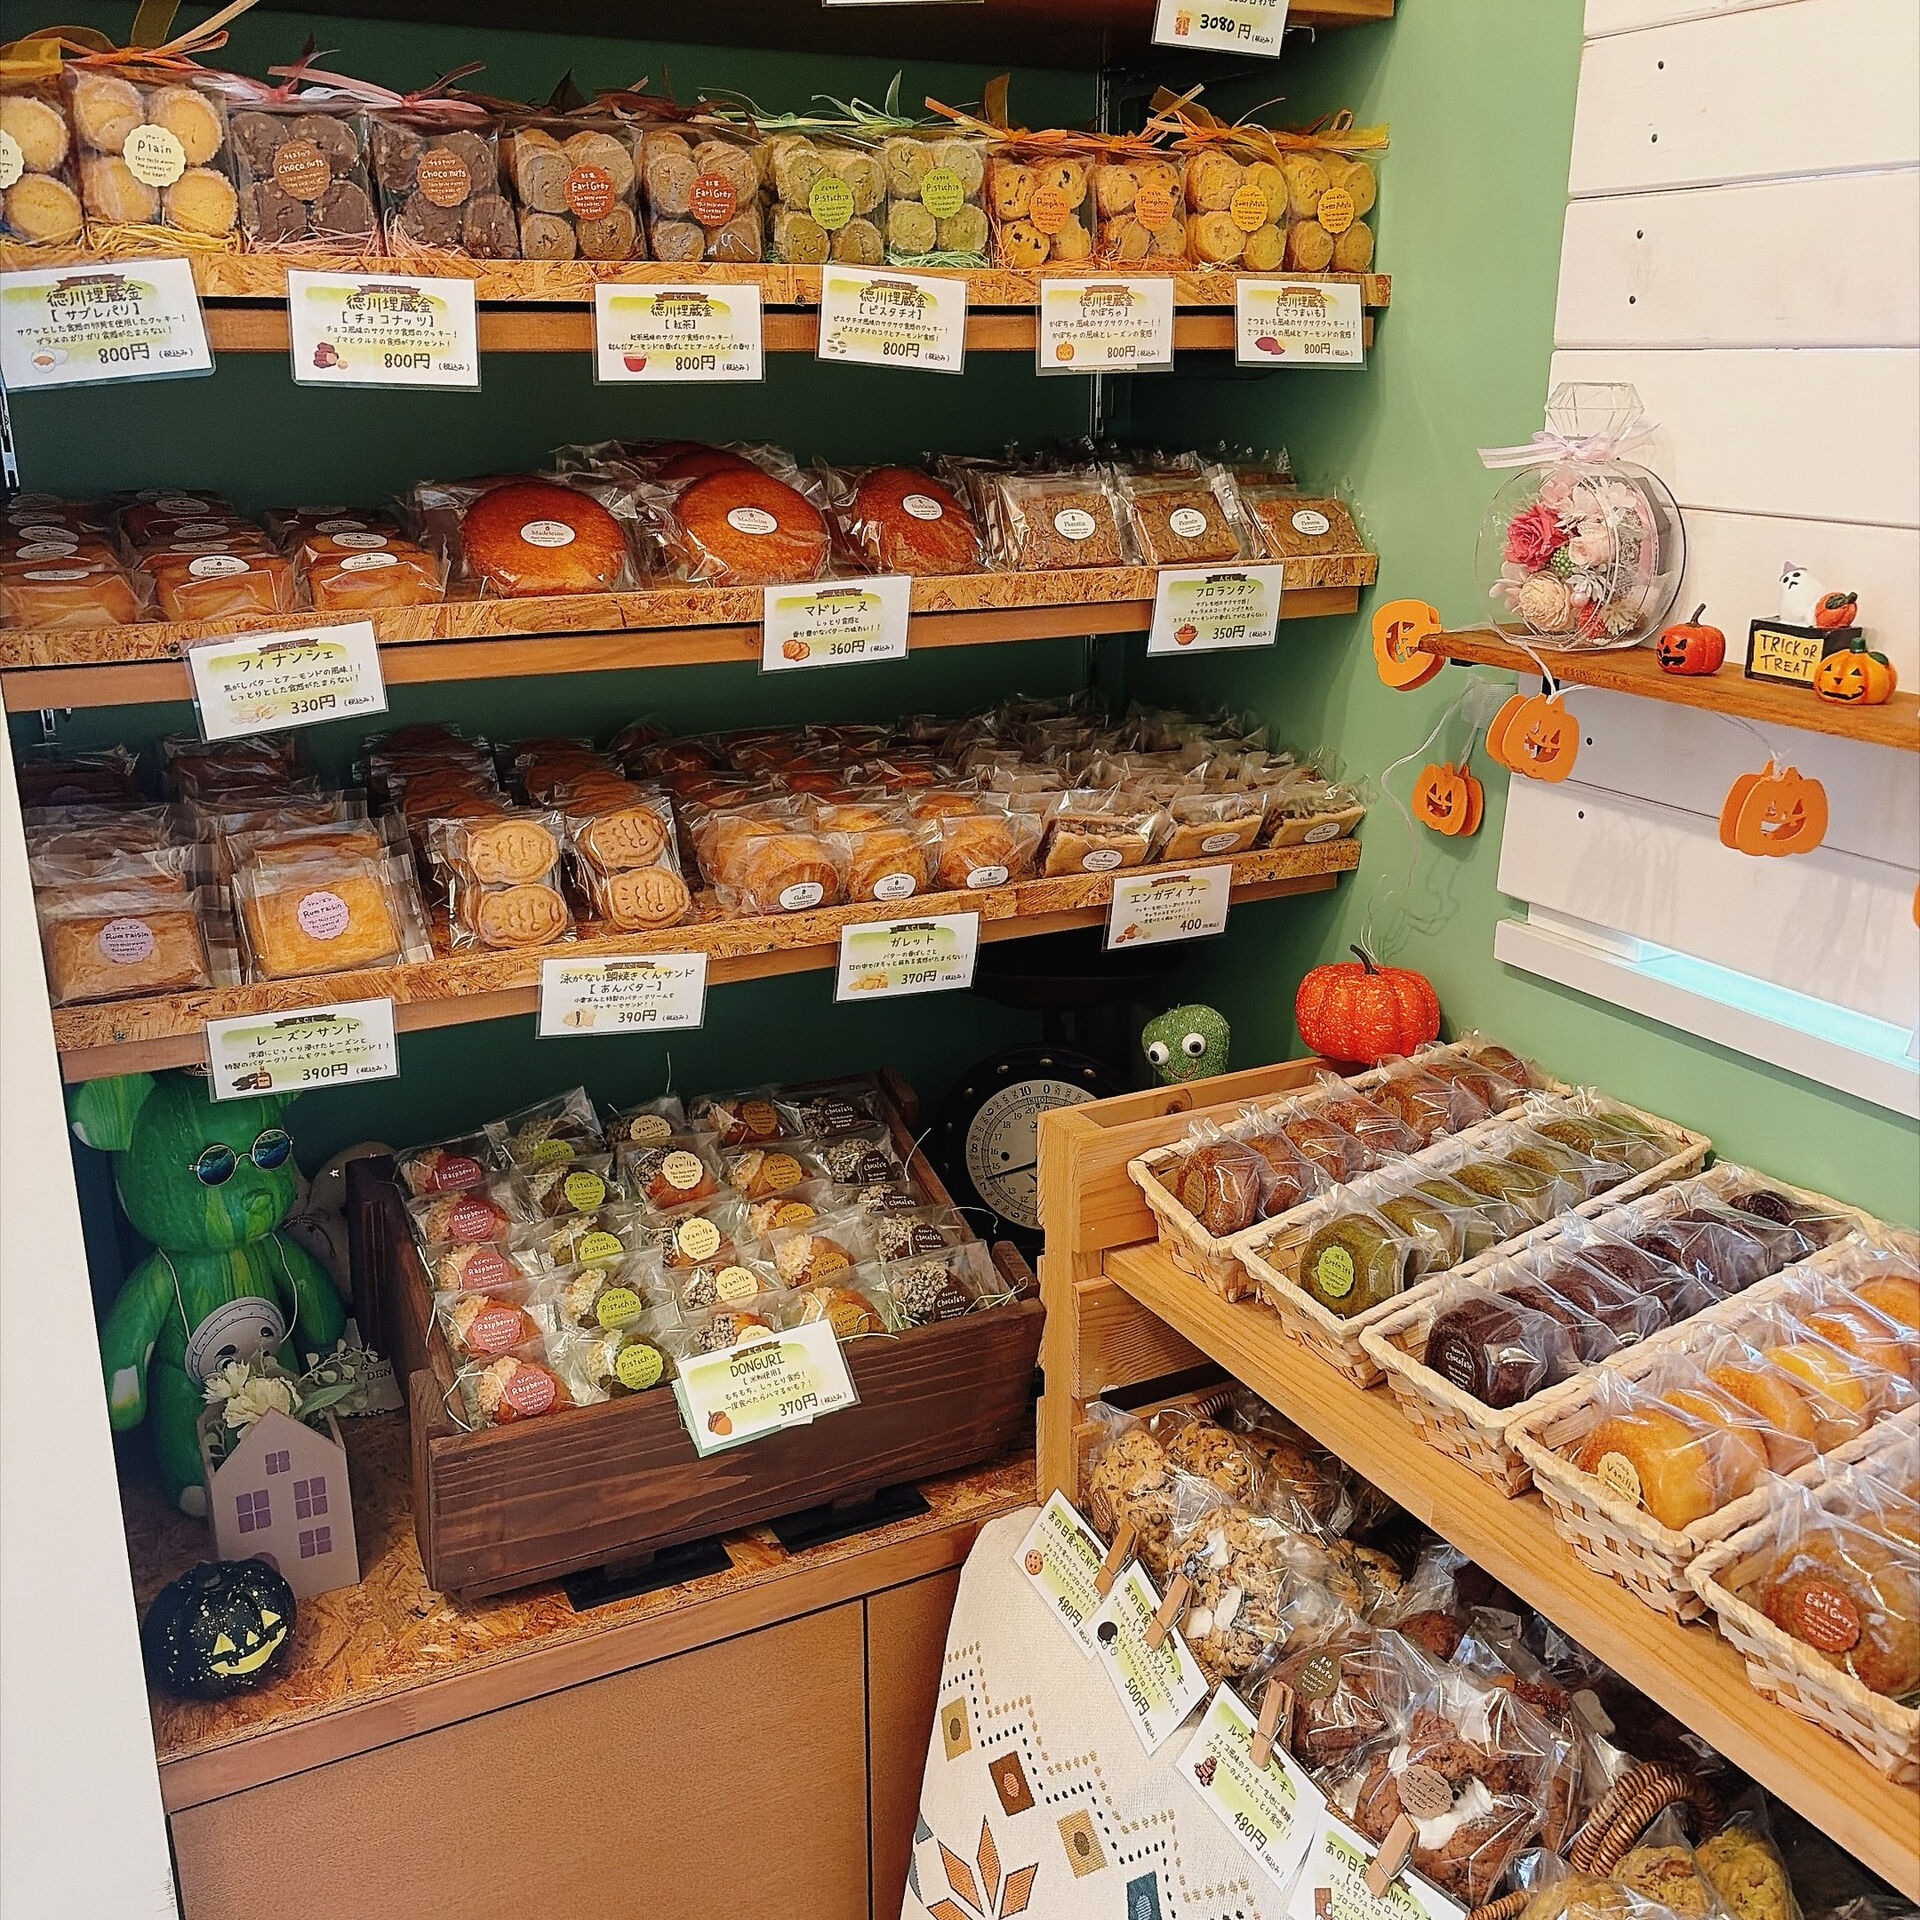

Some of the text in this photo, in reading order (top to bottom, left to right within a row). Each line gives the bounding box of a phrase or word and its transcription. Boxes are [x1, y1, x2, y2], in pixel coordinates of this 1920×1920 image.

[137, 139, 172, 154] Plain
[572, 182, 609, 191] Earl Grey
[695, 189, 732, 199] Earl Grey
[47, 283, 143, 307] 徳川埋蔵金
[859, 287, 928, 309] 徳川埋蔵金
[1079, 294, 1135, 307] 徳川埋蔵金
[1277, 295, 1328, 308] 徳川埋蔵金
[346, 294, 435, 313] 徳川埋蔵金
[651, 303, 714, 317] 徳川埋蔵金
[98, 342, 150, 363] 800円
[883, 341, 920, 358] 800円
[1107, 345, 1136, 358] 800円
[1304, 342, 1331, 355] 800円
[384, 352, 431, 369] 800円
[675, 355, 716, 371] 800円
[1196, 585, 1256, 598] フロランタン
[805, 601, 868, 616] マドレーヌ
[1212, 625, 1245, 640] 350円
[830, 639, 865, 655] 360円
[1760, 634, 1802, 656] TRICK
[237, 649, 334, 672] フィナンシェ
[1760, 654, 1812, 677] TREAT
[291, 694, 336, 714] 330円
[1130, 885, 1207, 904] エンガディナー
[303, 903, 343, 919] Rum raisin
[1180, 918, 1202, 932] 400
[891, 934, 934, 948] ガレット
[901, 970, 937, 985] 370円
[618, 1009, 656, 1023] 390円
[256, 1023, 360, 1046] レーズンサンド
[302, 1062, 348, 1081] 390円
[1019, 1085, 1032, 1096] 10
[1043, 1084, 1051, 1094] 0
[634, 1122, 663, 1134] Vanilla
[971, 1143, 978, 1152] 8
[668, 1160, 697, 1170] Vanilla
[441, 1167, 476, 1181] Raspberry
[568, 1180, 601, 1190] Pistachio
[453, 1208, 489, 1221] Raspberry
[781, 1211, 808, 1224] Almond
[684, 1228, 713, 1242] Vanilla
[584, 1243, 618, 1254] Pistachio
[468, 1263, 504, 1275] Raspberry
[817, 1264, 844, 1278] Almond
[721, 1276, 749, 1289] Vanilla
[601, 1299, 637, 1313] Pistachio
[477, 1318, 516, 1332] Raspberry
[621, 1353, 657, 1370] Pistachio
[730, 1352, 785, 1378] DONGURI
[511, 1379, 549, 1395] Raspberry
[779, 1392, 818, 1417] 370円
[1607, 1462, 1635, 1492] Vanilla
[1057, 1595, 1083, 1628] 480円
[1805, 1593, 1854, 1628] Earl Grey
[1309, 1659, 1333, 1680] Kokuto
[1124, 1677, 1150, 1716] 500円
[1234, 1811, 1268, 1852] 480円
